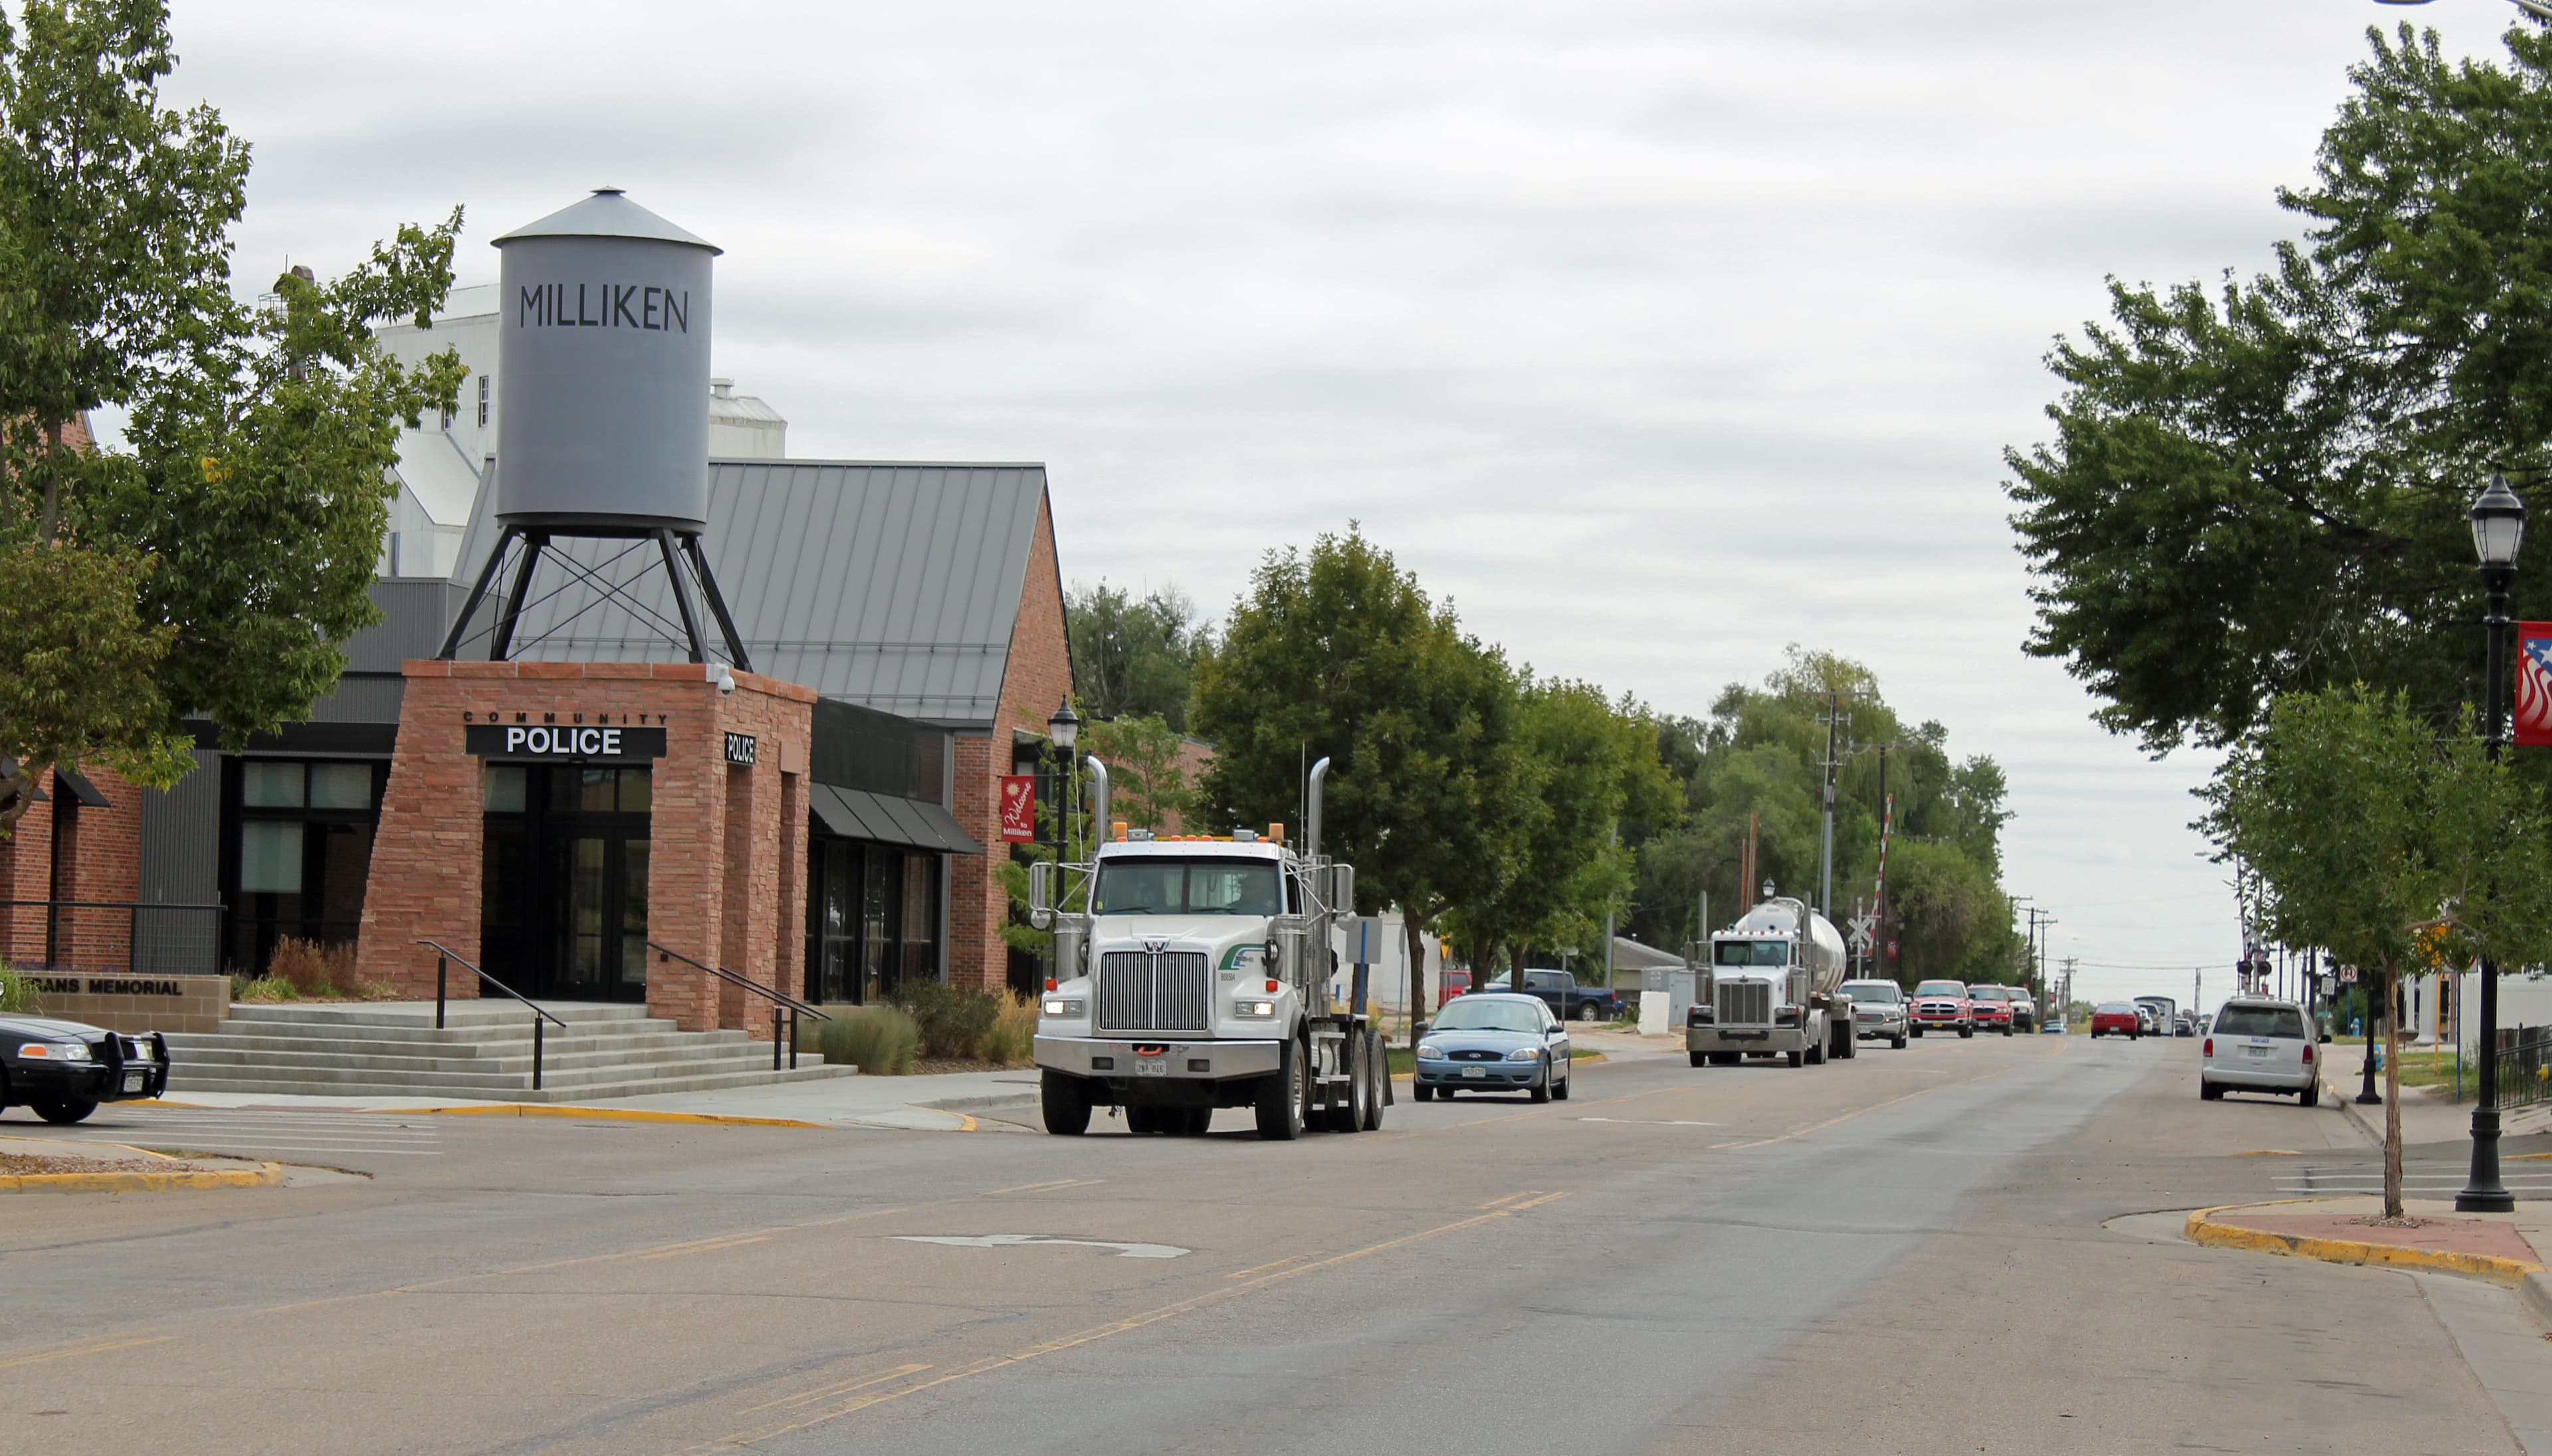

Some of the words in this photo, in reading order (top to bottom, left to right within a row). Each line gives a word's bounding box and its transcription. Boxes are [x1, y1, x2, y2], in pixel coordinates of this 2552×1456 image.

[521, 283, 688, 334] MILLIKEN
[464, 711, 667, 725] COMMUNITY
[507, 727, 621, 755] POLICE
[728, 734, 754, 763] POLICE
[1004, 781, 1031, 826] Welcome
[1003, 827, 1032, 837] Milliken
[89, 979, 183, 995] MEMORIAL
